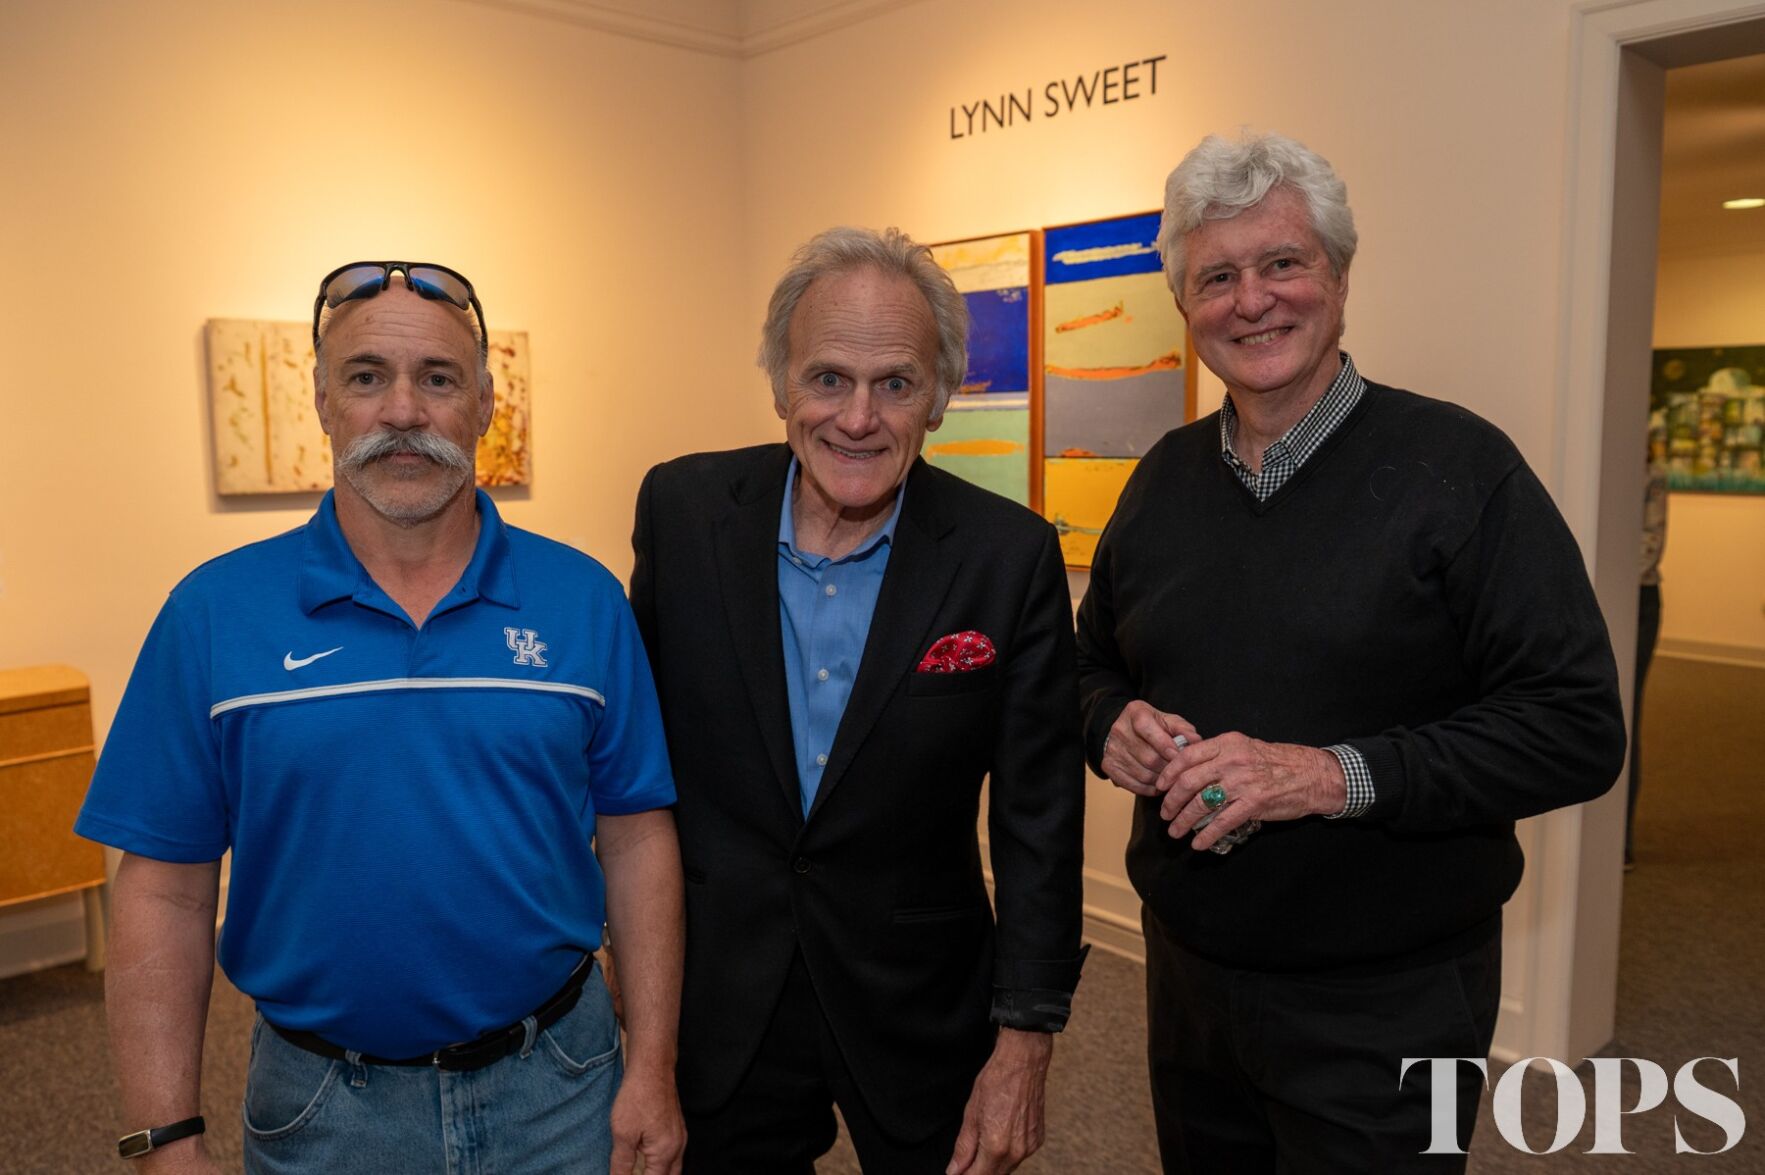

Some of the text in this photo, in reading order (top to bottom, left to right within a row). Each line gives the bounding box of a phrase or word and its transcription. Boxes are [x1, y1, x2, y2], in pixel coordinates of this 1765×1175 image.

[951, 55, 1167, 140] LYNN SWEET
[504, 627, 548, 667] UK
